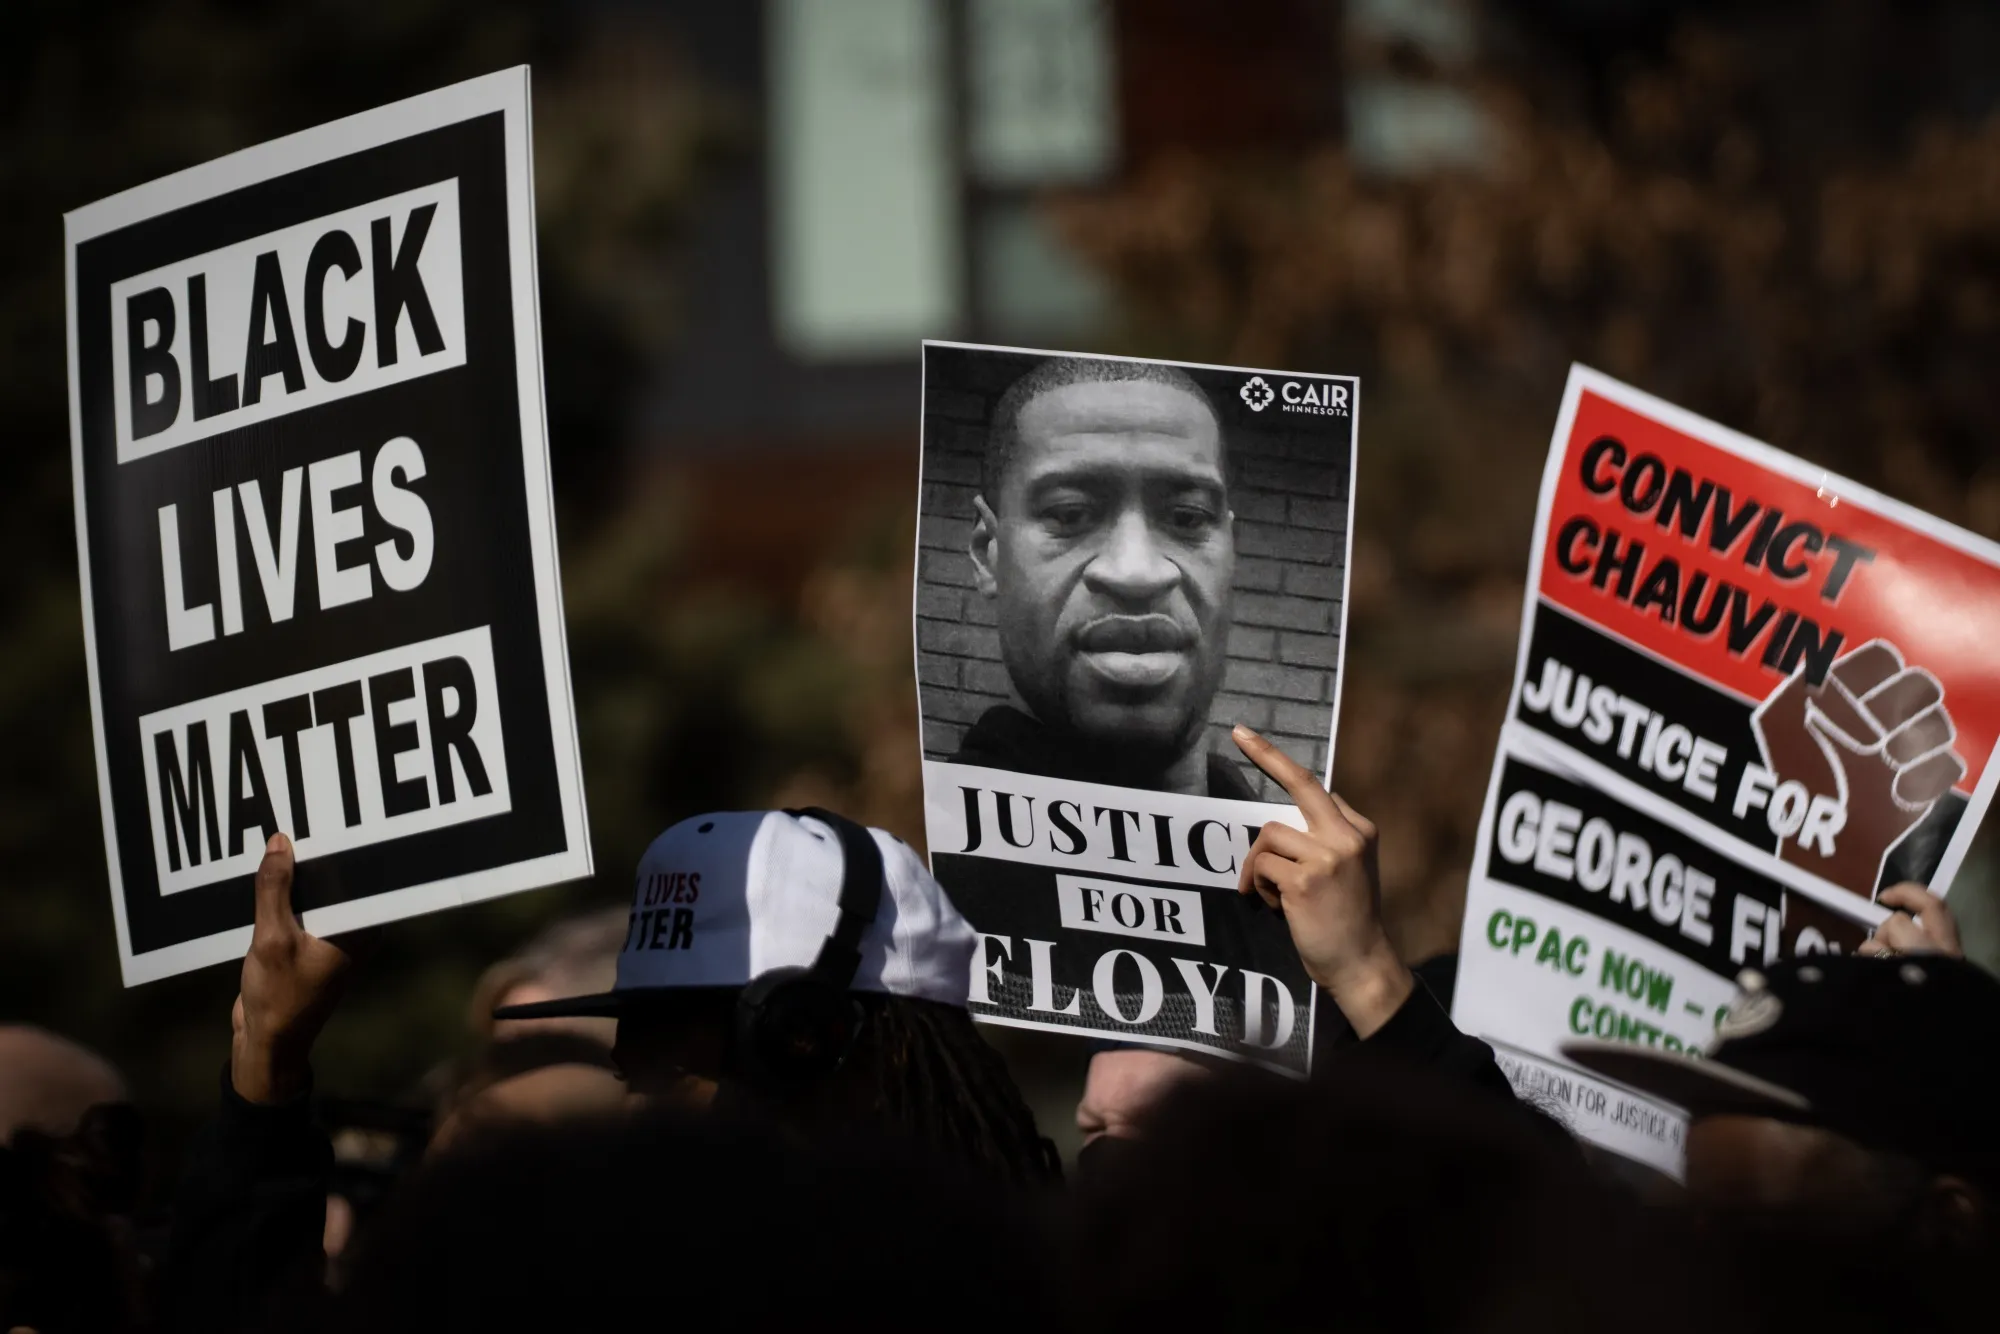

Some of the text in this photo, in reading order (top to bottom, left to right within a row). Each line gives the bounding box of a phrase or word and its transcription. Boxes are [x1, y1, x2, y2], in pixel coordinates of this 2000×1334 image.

[127, 201, 446, 442] BLACK
[1281, 381, 1348, 408] CAIR
[1282, 404, 1349, 417] MINNESOTA
[158, 436, 435, 651] LIVES
[1580, 435, 1877, 605] CONVICT
[1556, 515, 1845, 690] CHAUVIN
[154, 655, 493, 873] MATTER
[1522, 657, 1848, 858] JUSTICE FOR
[644, 872, 702, 906] LIVES
[957, 785, 1262, 875] JUSTIC
[1498, 790, 1717, 946] GEORGE
[1077, 886, 1187, 935] FOR
[1486, 908, 1590, 977] CPAC
[1600, 948, 1675, 1016] NOW
[968, 932, 1296, 1050] FLOYD
[1576, 1084, 1607, 1119] FOR
[1610, 1101, 1667, 1143] JUSTICE
